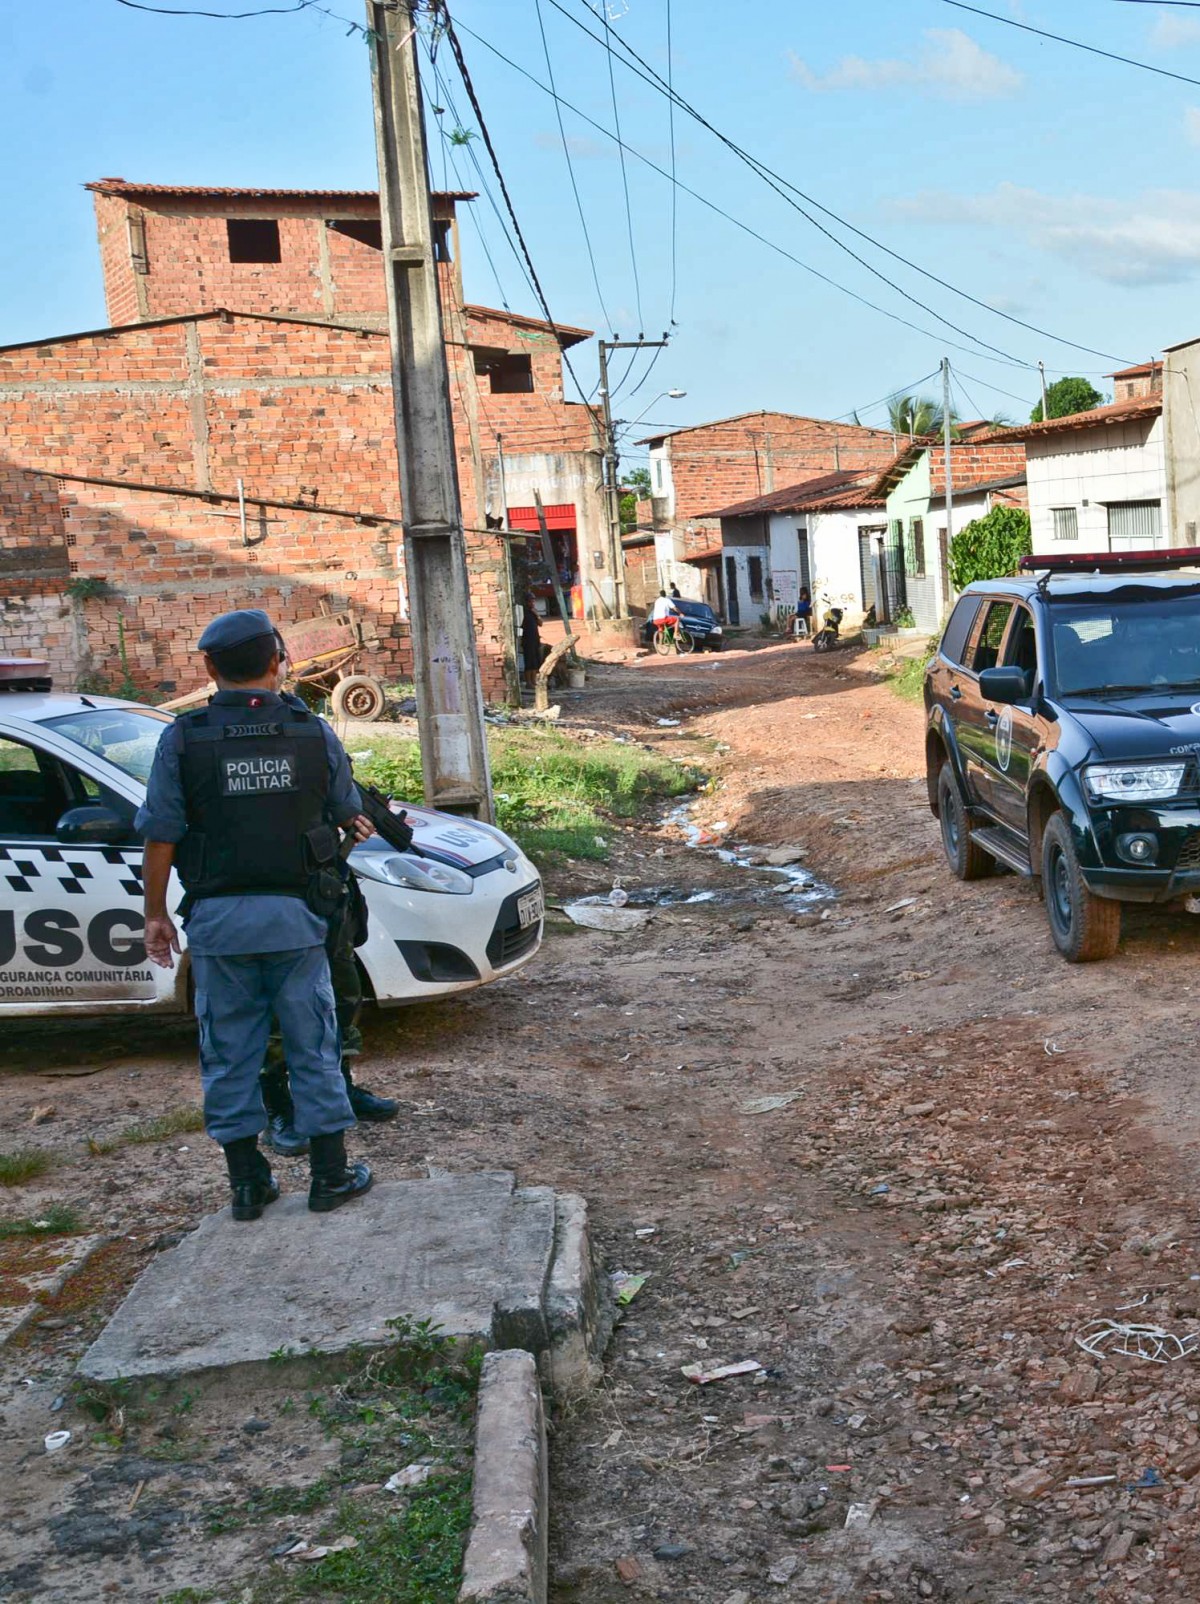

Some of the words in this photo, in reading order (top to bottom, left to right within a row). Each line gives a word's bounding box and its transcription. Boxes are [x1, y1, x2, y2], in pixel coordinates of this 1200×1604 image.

[226, 757, 291, 776] POLÍCIA
[227, 774, 292, 792] MILITAR
[0, 908, 148, 968] SC
[65, 967, 154, 982] COMUNITÁRIA
